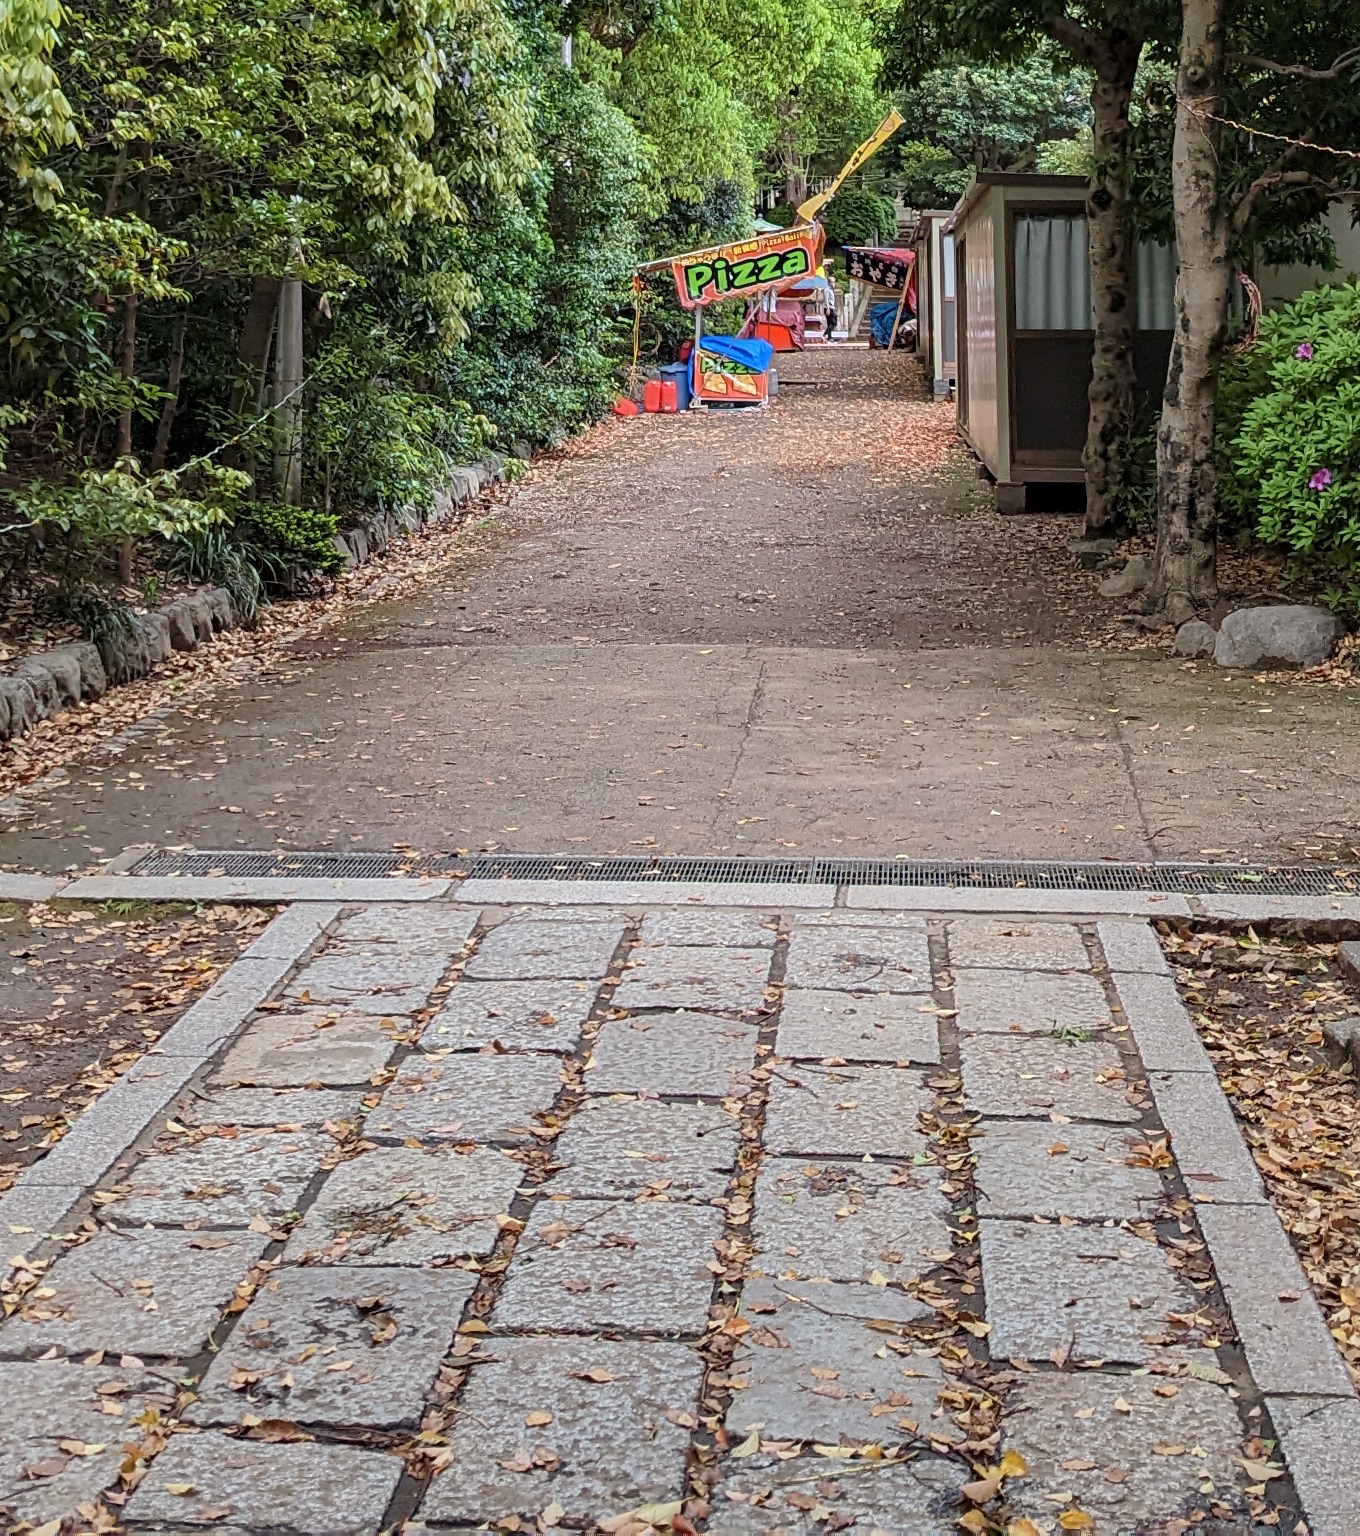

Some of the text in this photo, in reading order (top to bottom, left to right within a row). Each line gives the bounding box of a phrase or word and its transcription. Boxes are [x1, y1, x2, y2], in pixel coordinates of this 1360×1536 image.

[685, 248, 809, 299] Pizza
[850, 260, 897, 288] おやき
